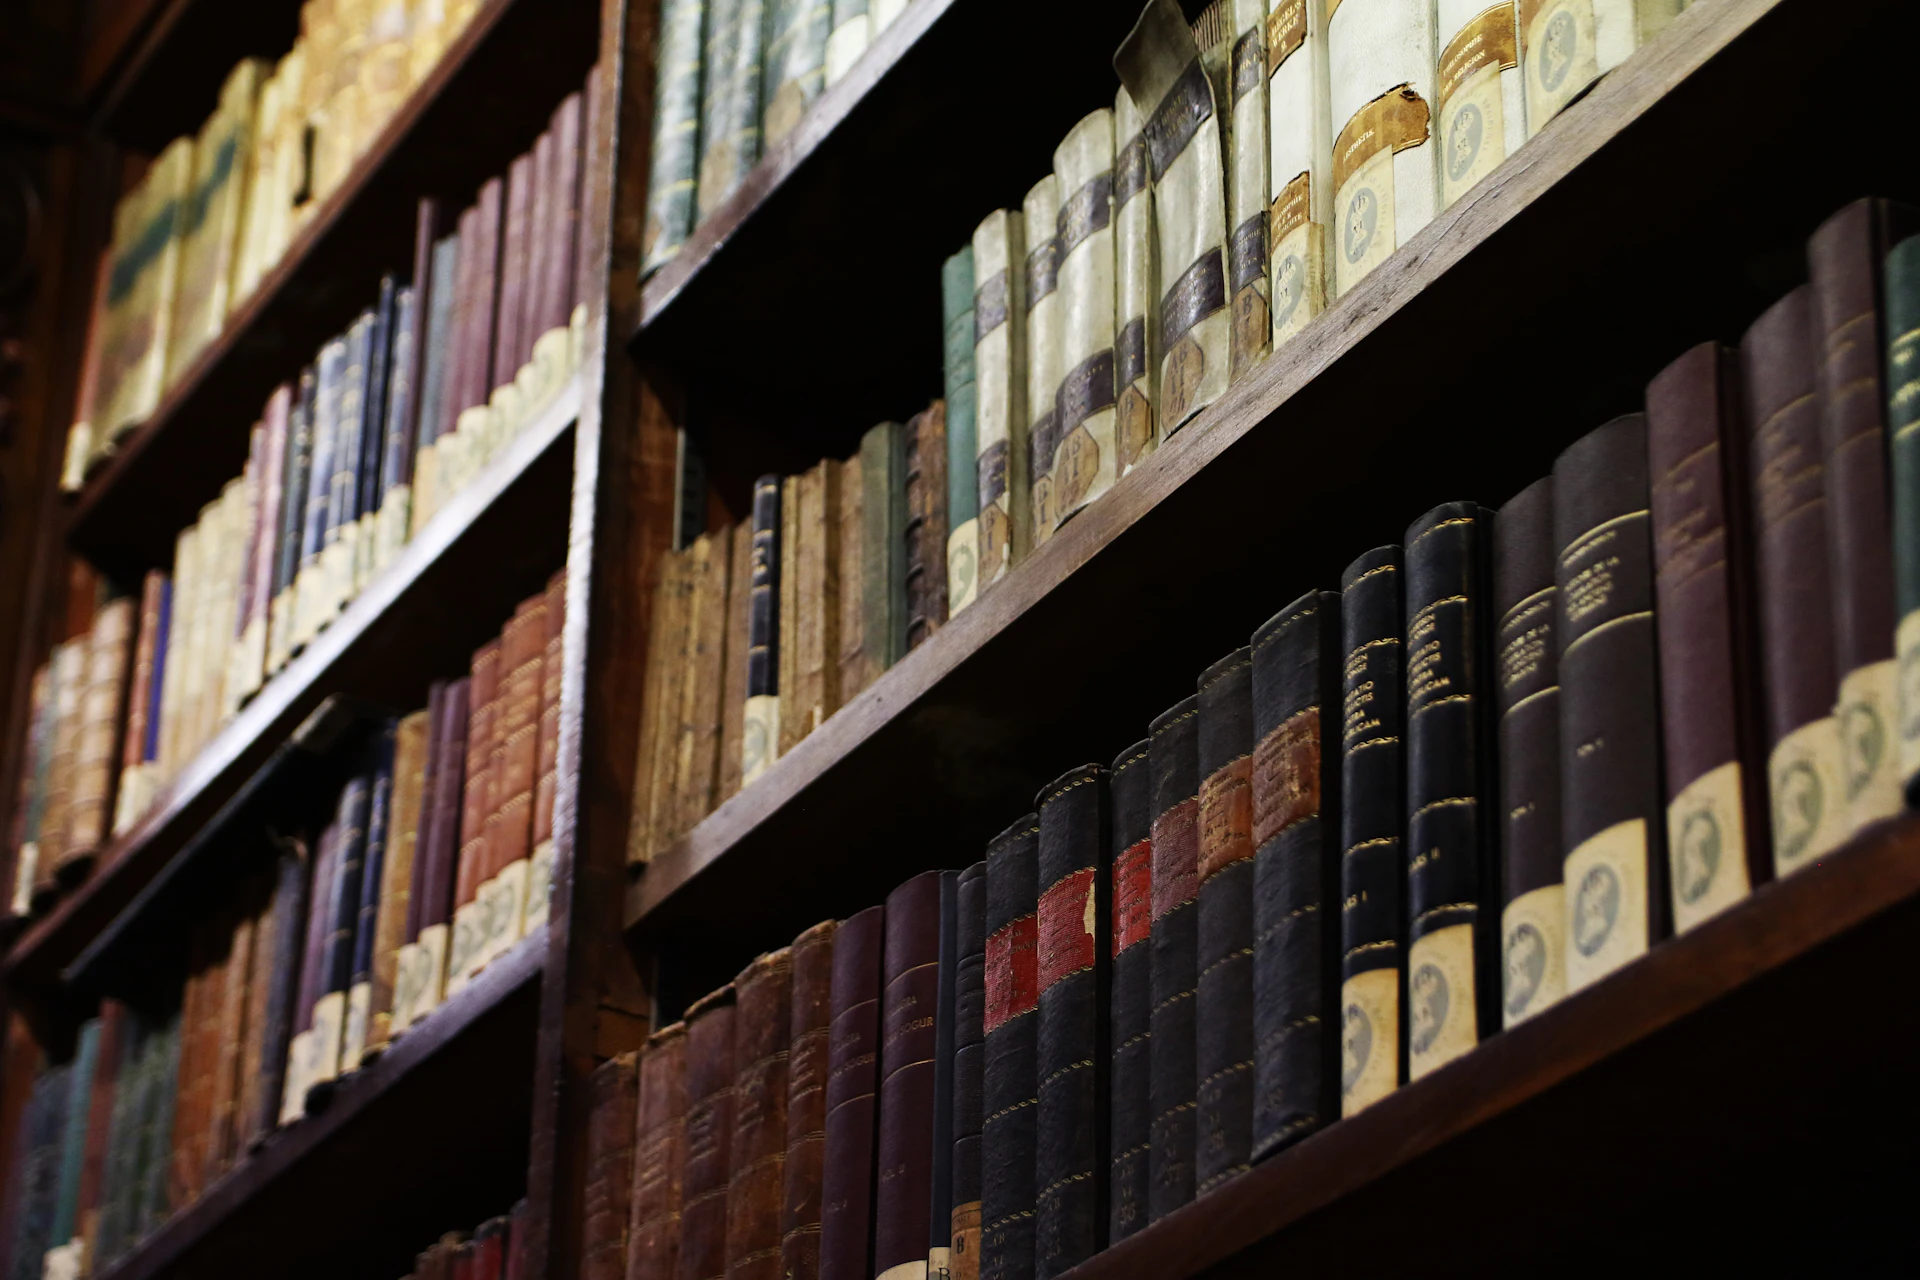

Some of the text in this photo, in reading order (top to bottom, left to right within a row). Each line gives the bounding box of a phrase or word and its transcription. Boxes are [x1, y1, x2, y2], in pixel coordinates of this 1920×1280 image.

[1272, 14, 1299, 48] WERKE
[1443, 33, 1483, 76] PHILOSOPHIE
[1453, 49, 1486, 81] RELIGION
[899, 1016, 934, 1036] SOGUR
